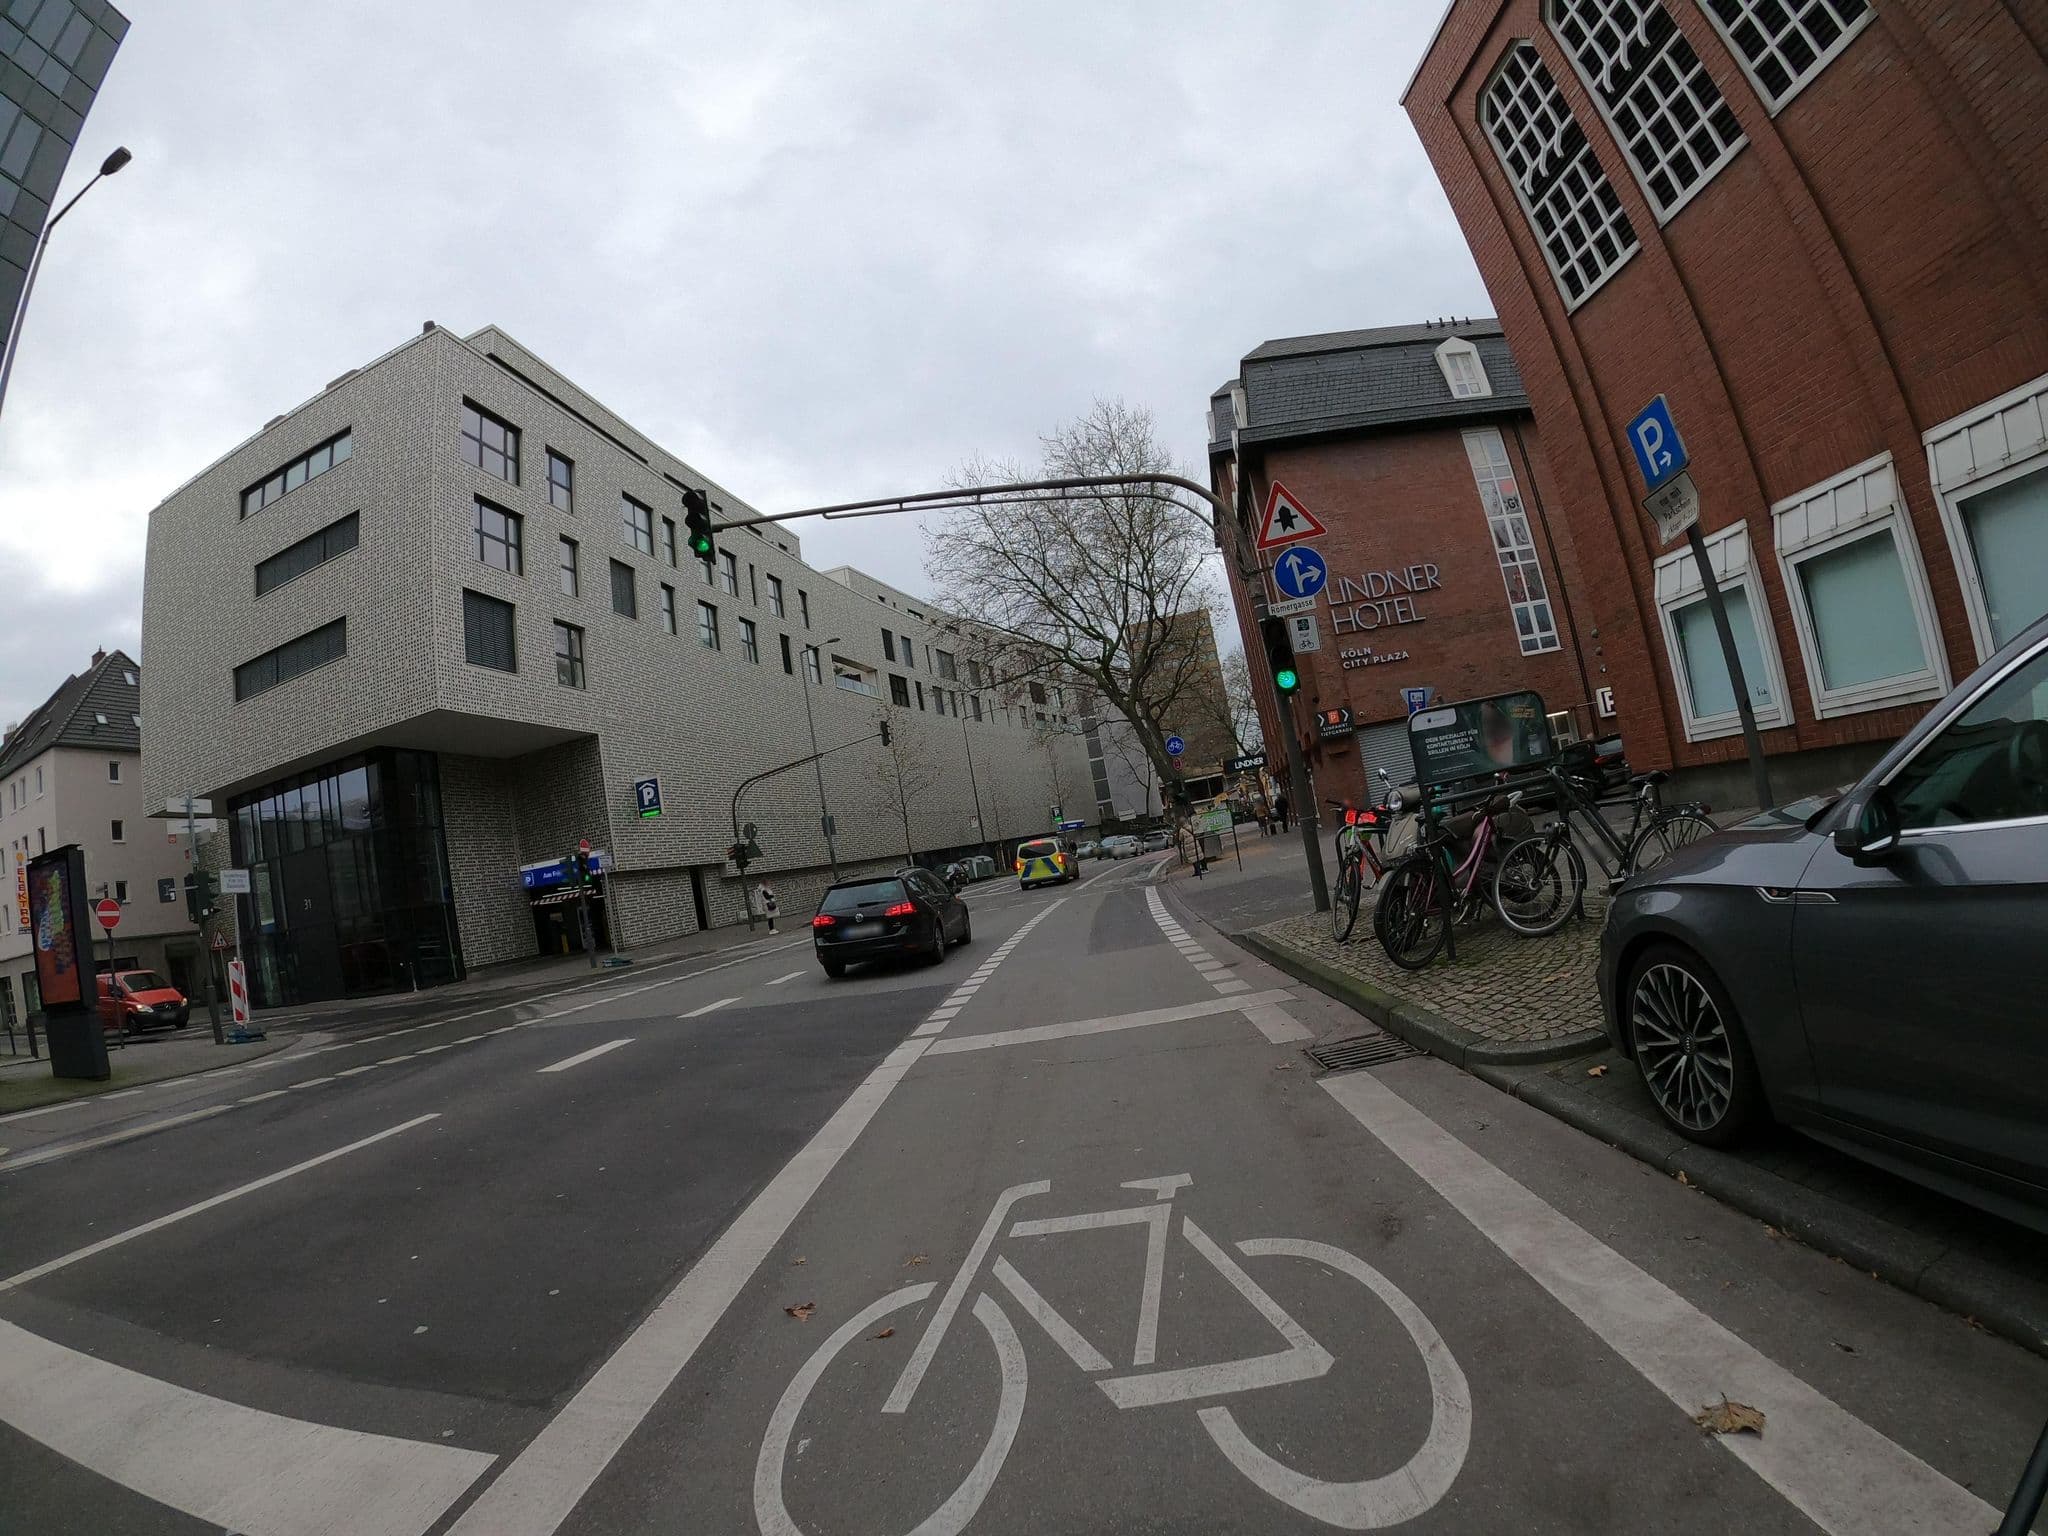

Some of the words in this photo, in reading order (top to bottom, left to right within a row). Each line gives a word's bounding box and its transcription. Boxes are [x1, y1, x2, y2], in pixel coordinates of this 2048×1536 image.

[1637, 417, 1663, 477] P
[1325, 563, 1442, 605] LINDNER
[1270, 599, 1313, 615] Römergasse
[1331, 596, 1427, 635] HOTEL
[1340, 647, 1371, 659] KÖLN
[1342, 657, 1369, 670] CITY
[1373, 650, 1410, 664] PLAZA
[1439, 731, 1467, 740] SPEZIALIST
[1456, 743, 1471, 751] KÖLN
[1234, 757, 1264, 769] LINDNER
[643, 786, 655, 806] P
[17, 866, 30, 925] ELEKTRO
[304, 898, 312, 910] 31
